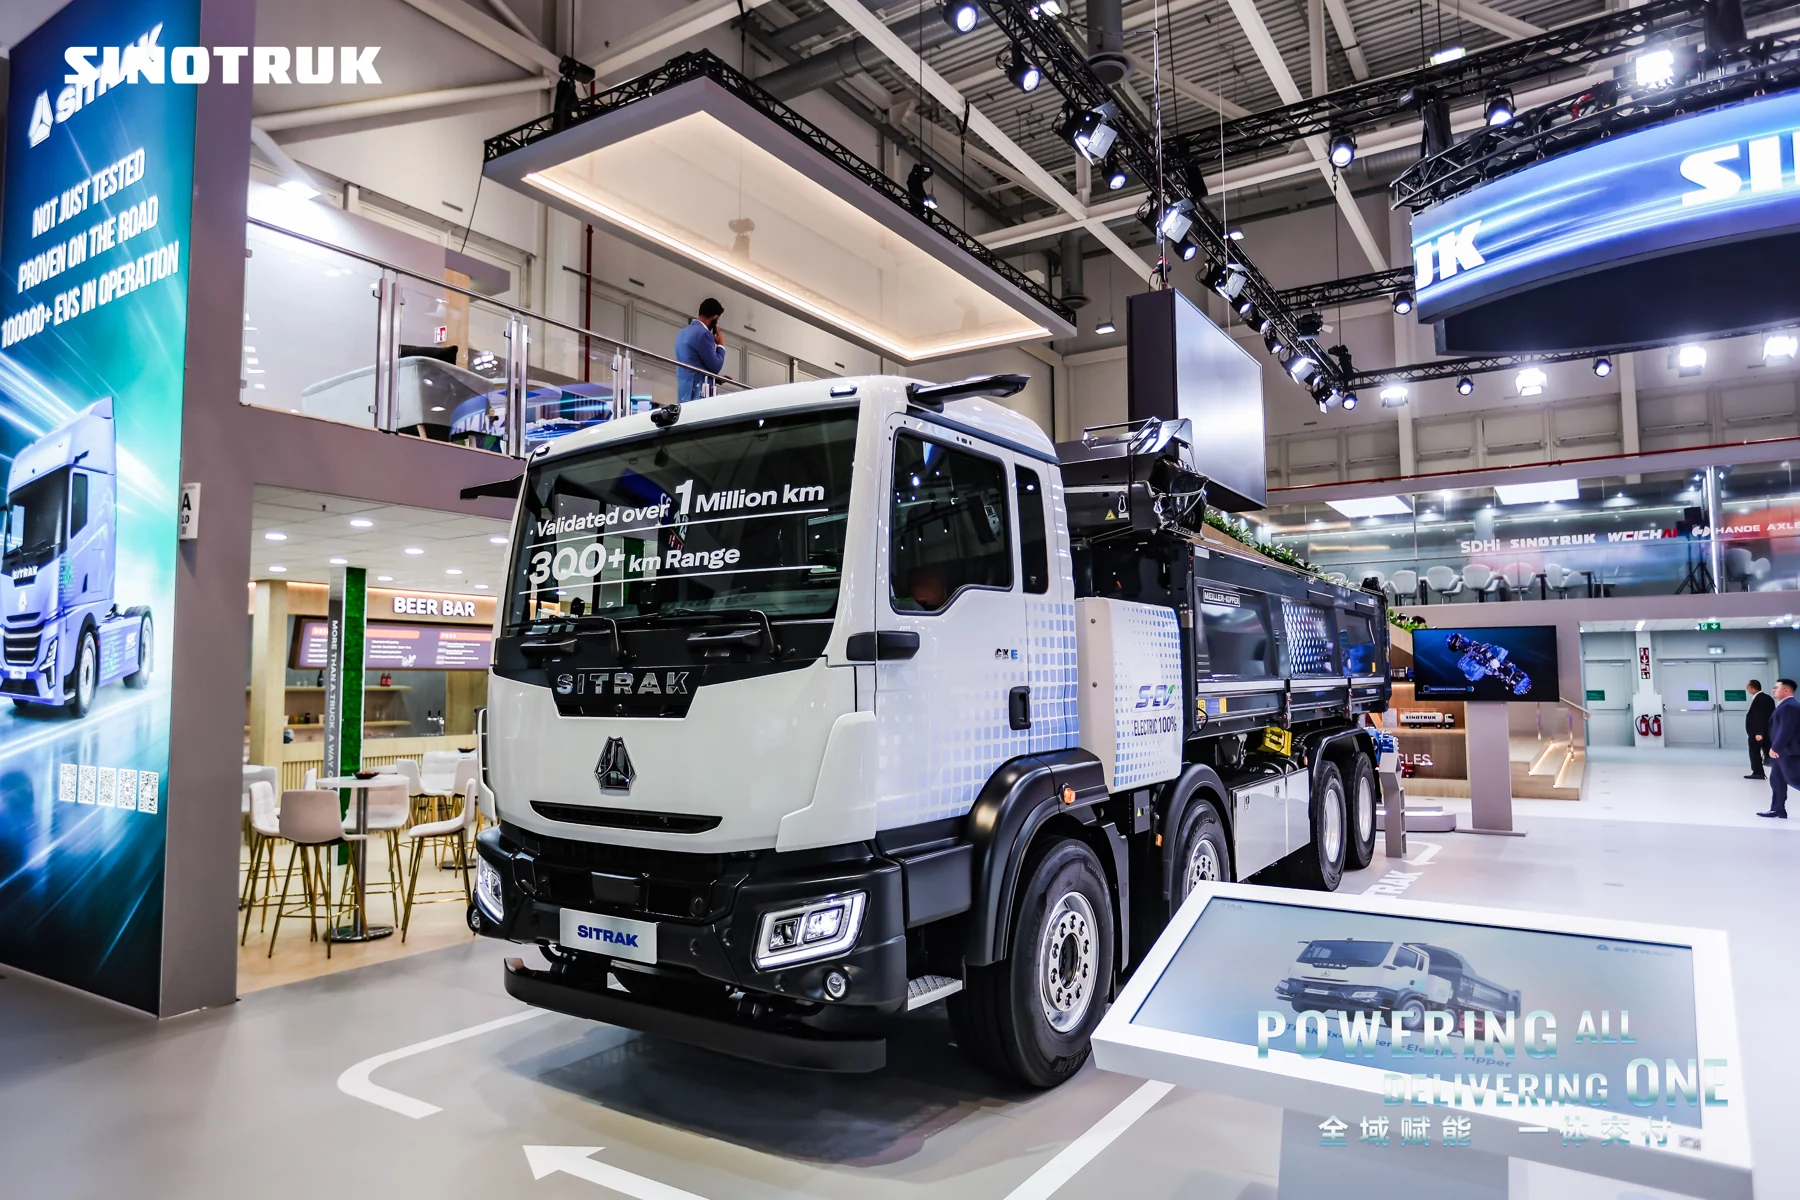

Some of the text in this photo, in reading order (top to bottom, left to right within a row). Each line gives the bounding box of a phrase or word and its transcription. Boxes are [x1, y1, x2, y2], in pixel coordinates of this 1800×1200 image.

[1680, 132, 1800, 206] SI
[32, 147, 145, 239] NOT JUST TESTED
[17, 195, 159, 294] PROVEN ON THE ROAD
[1, 239, 180, 349] 100000+ EVS IN OPERATION
[181, 493, 191, 511] A
[537, 479, 825, 537] Validated over 1 Million km
[1510, 534, 1596, 548] SINOTRUK
[1716, 525, 1760, 534] HANDE
[12, 565, 38, 580] SITRAK
[529, 543, 741, 585] 300+ km Range
[393, 596, 476, 617] BEER BAR
[330, 683, 336, 692] A
[556, 672, 690, 695] SITRAK
[1134, 716, 1177, 736] ELECTRIC 100%
[577, 924, 639, 948] SITRAK
